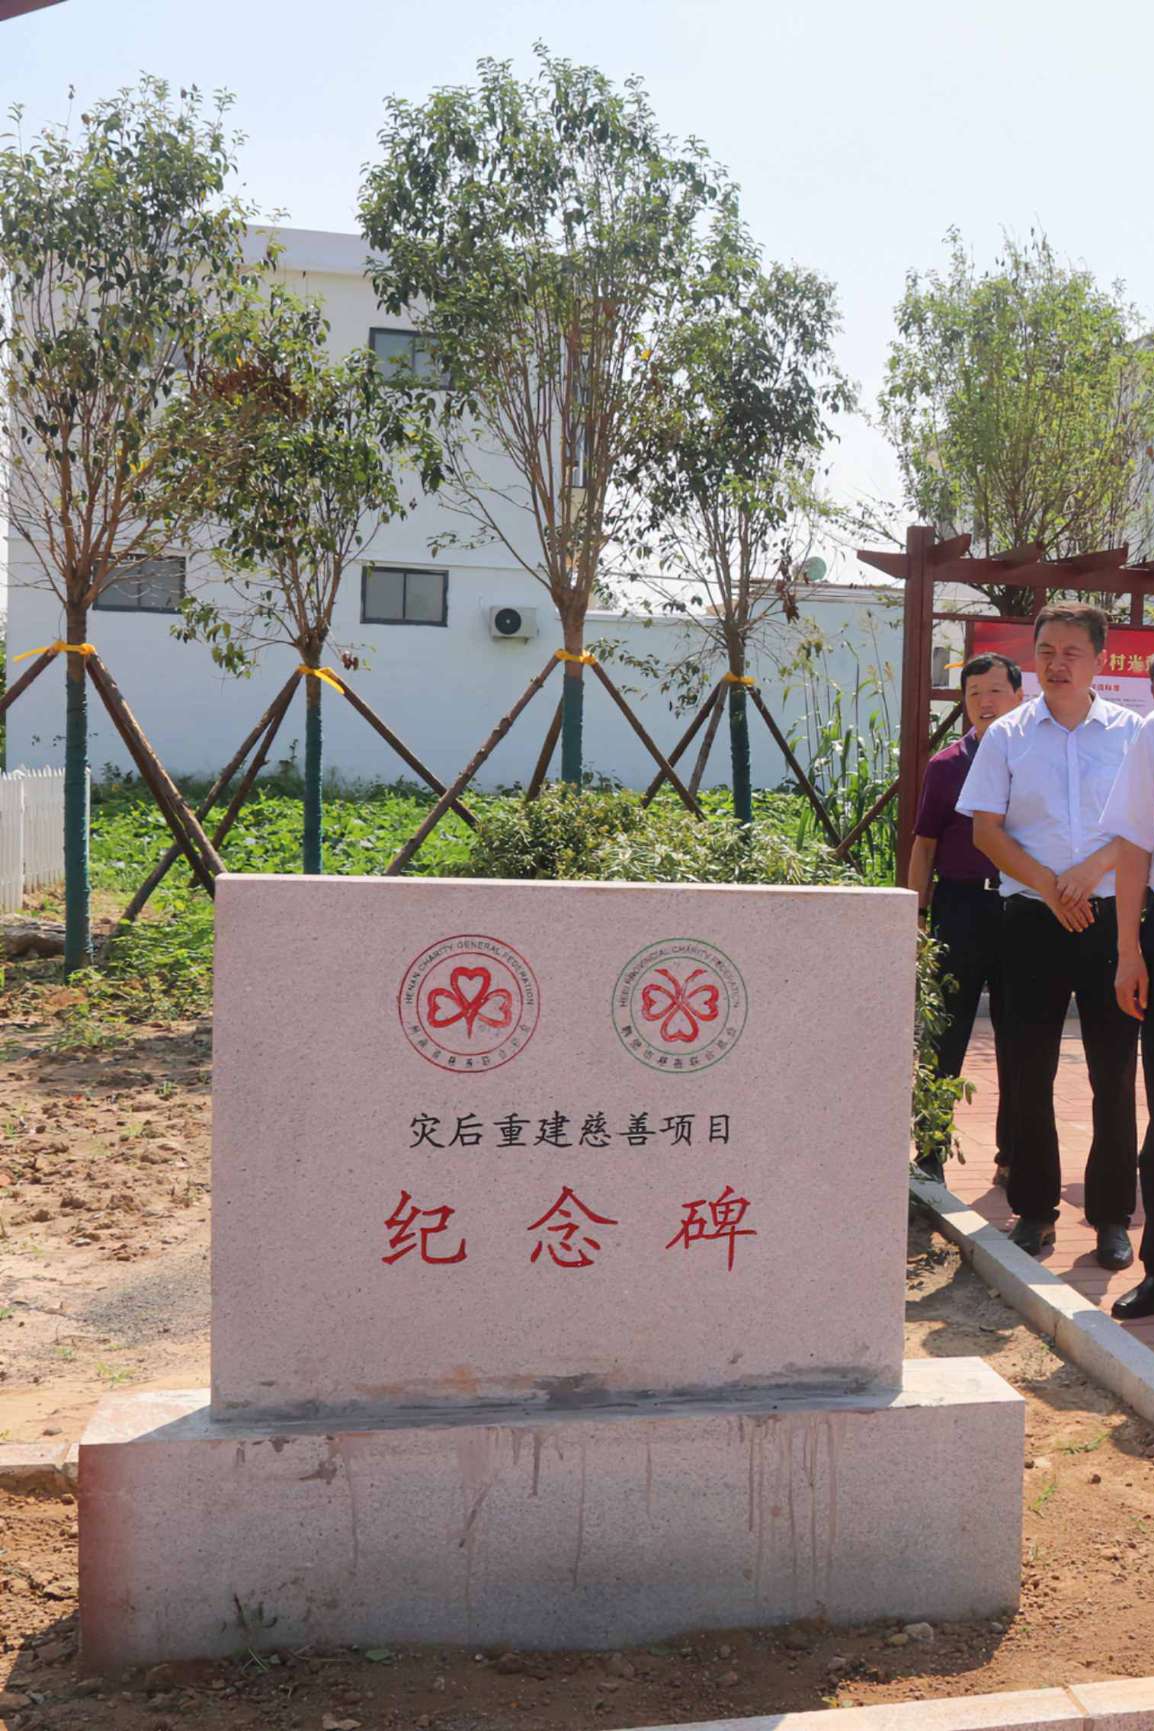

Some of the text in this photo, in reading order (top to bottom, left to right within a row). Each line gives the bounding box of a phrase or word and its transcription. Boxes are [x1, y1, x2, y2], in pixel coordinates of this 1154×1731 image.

[406, 971, 421, 1005] HENAN
[418, 943, 454, 972] CHARITY
[457, 940, 502, 956] GENERAL
[409, 1109, 731, 1149] 灾后重建慈善项目
[381, 1184, 758, 1272] 纪念碑
